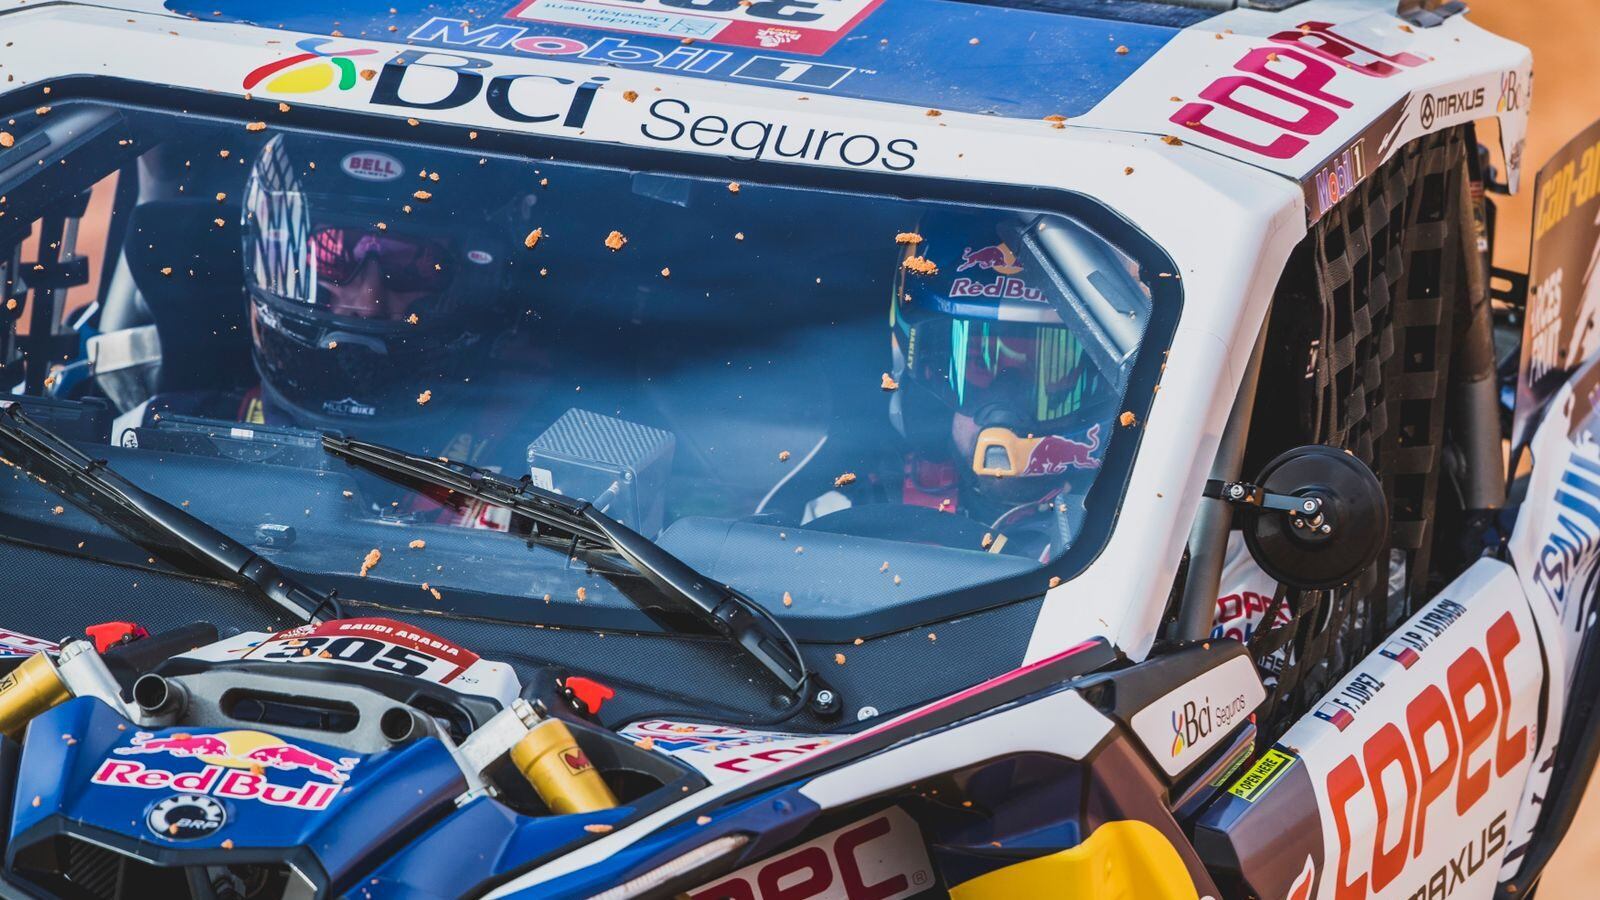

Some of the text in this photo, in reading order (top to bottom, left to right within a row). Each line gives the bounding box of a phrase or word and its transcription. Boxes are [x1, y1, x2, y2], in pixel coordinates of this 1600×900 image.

[407, 16, 733, 74] Mobil
[1437, 87, 1485, 119] MAXUS
[640, 98, 918, 171] Seguros
[349, 156, 394, 174] BELL
[949, 276, 1049, 303] Red Bu
[264, 637, 437, 678] 305
[395, 629, 460, 656] ARABIA
[1341, 672, 1385, 706] LOPEZ
[1184, 694, 1246, 748] Bci Seguros
[92, 758, 341, 811] Red Bull
[1239, 772, 1263, 790] OPEN
[1254, 757, 1279, 776] HERE
[176, 817, 219, 831] BRP
